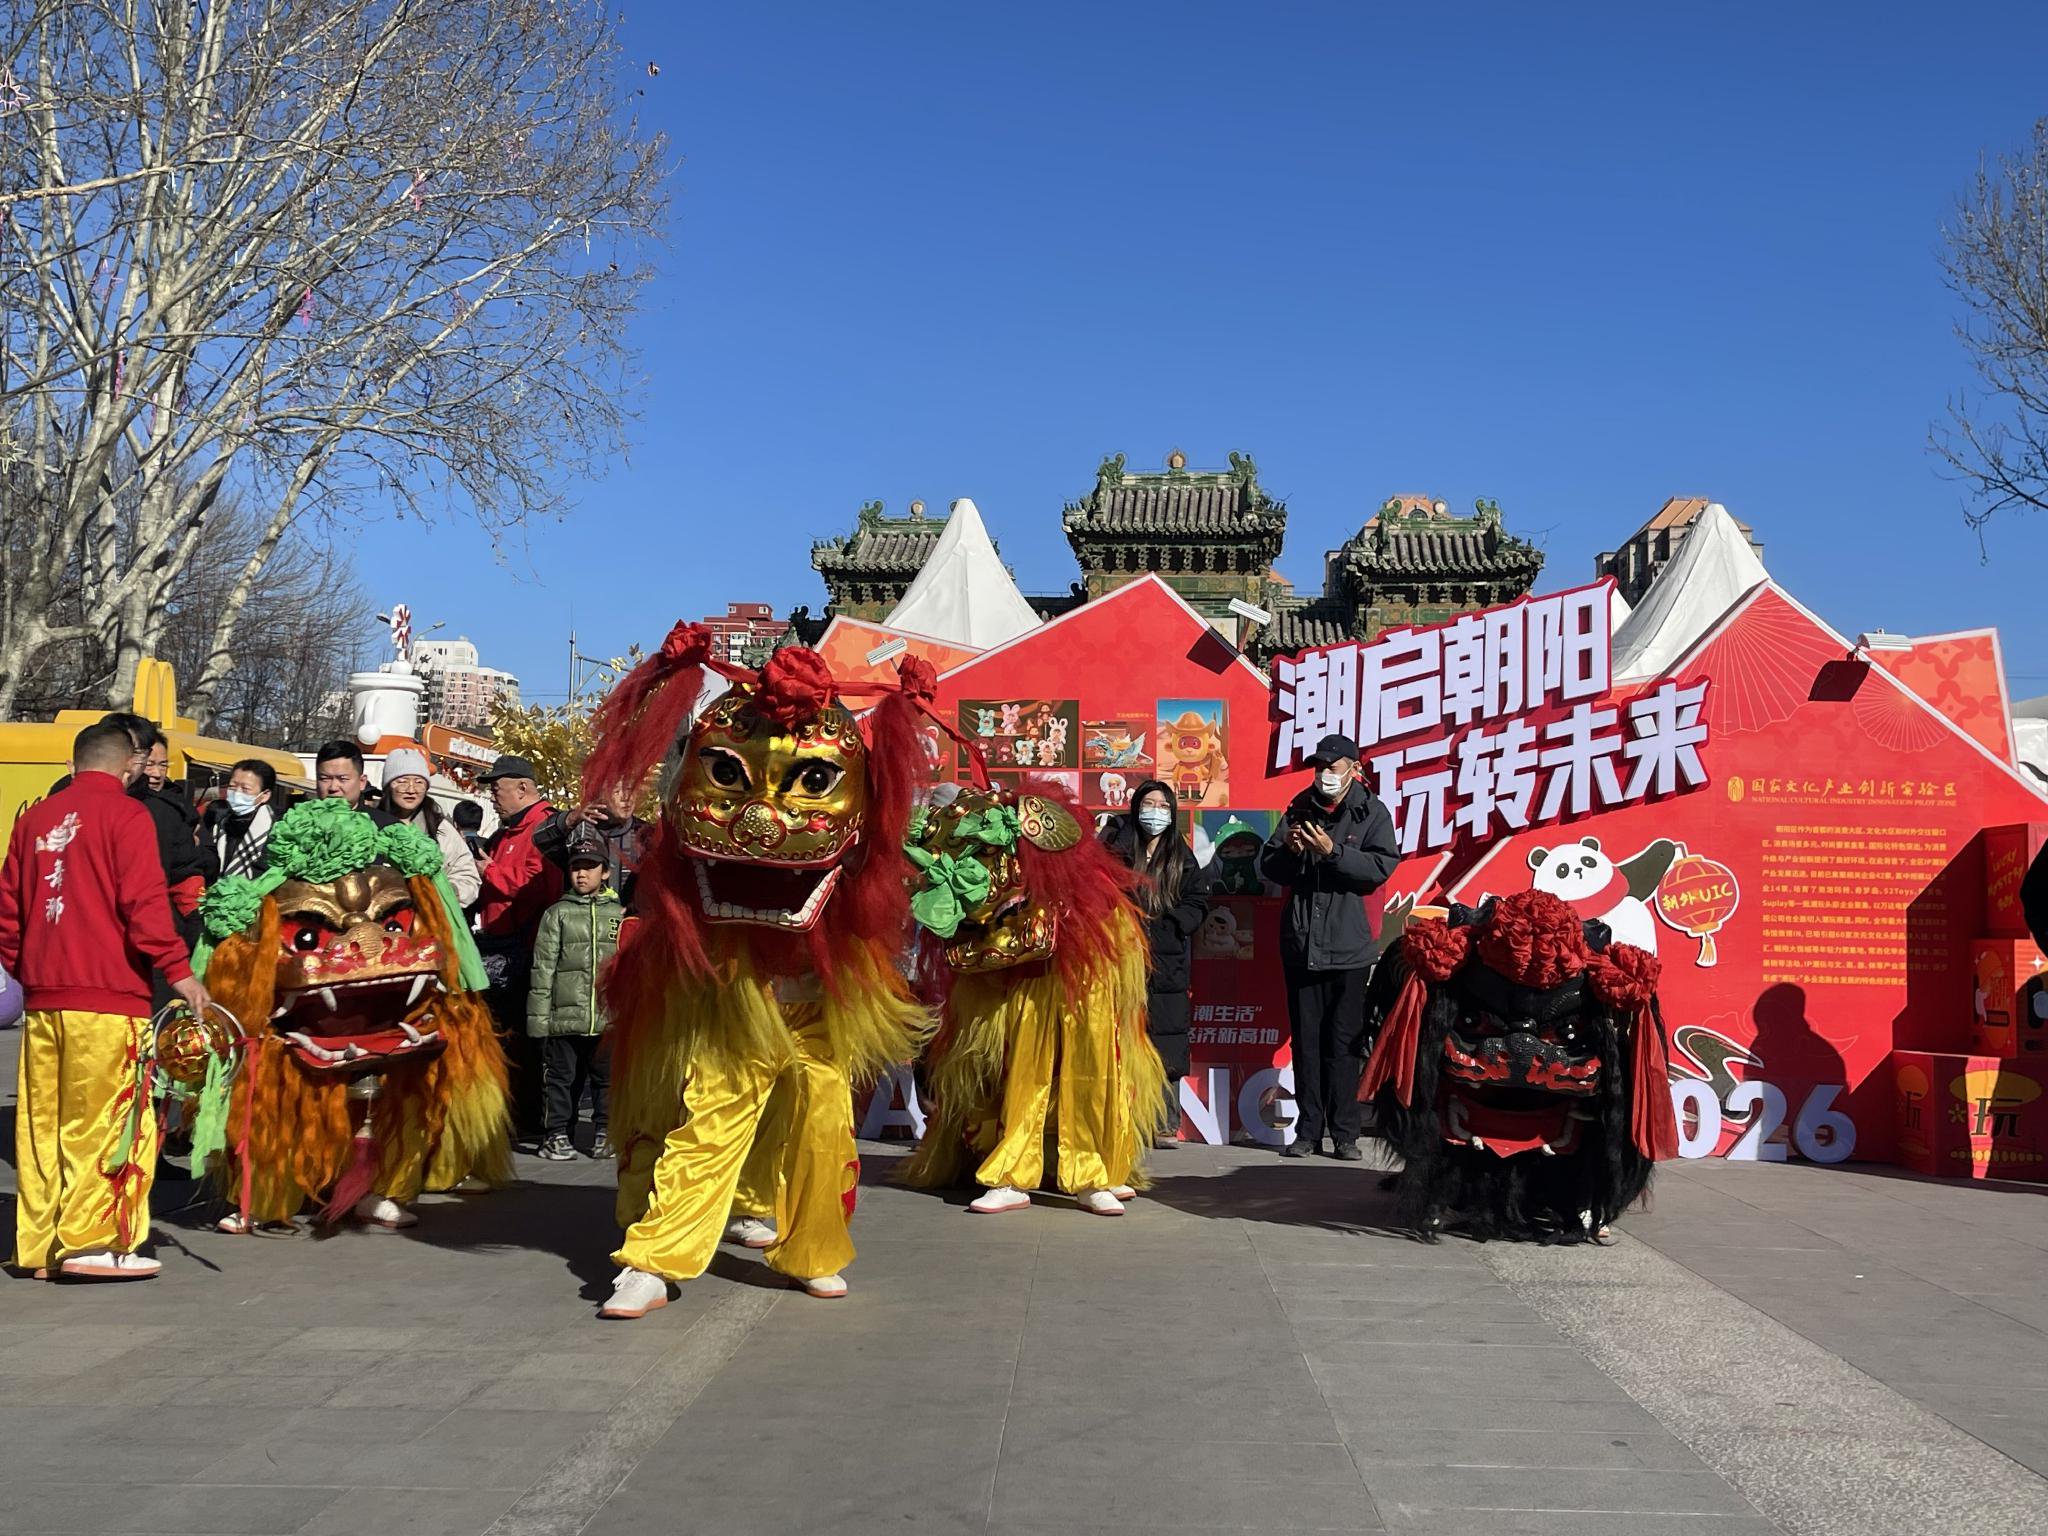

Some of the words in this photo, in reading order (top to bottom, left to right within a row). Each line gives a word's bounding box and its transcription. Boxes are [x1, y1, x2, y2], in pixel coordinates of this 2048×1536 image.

[1276, 578, 1616, 768] 潮启朝阳
[1371, 681, 1709, 855] 玩转未来
